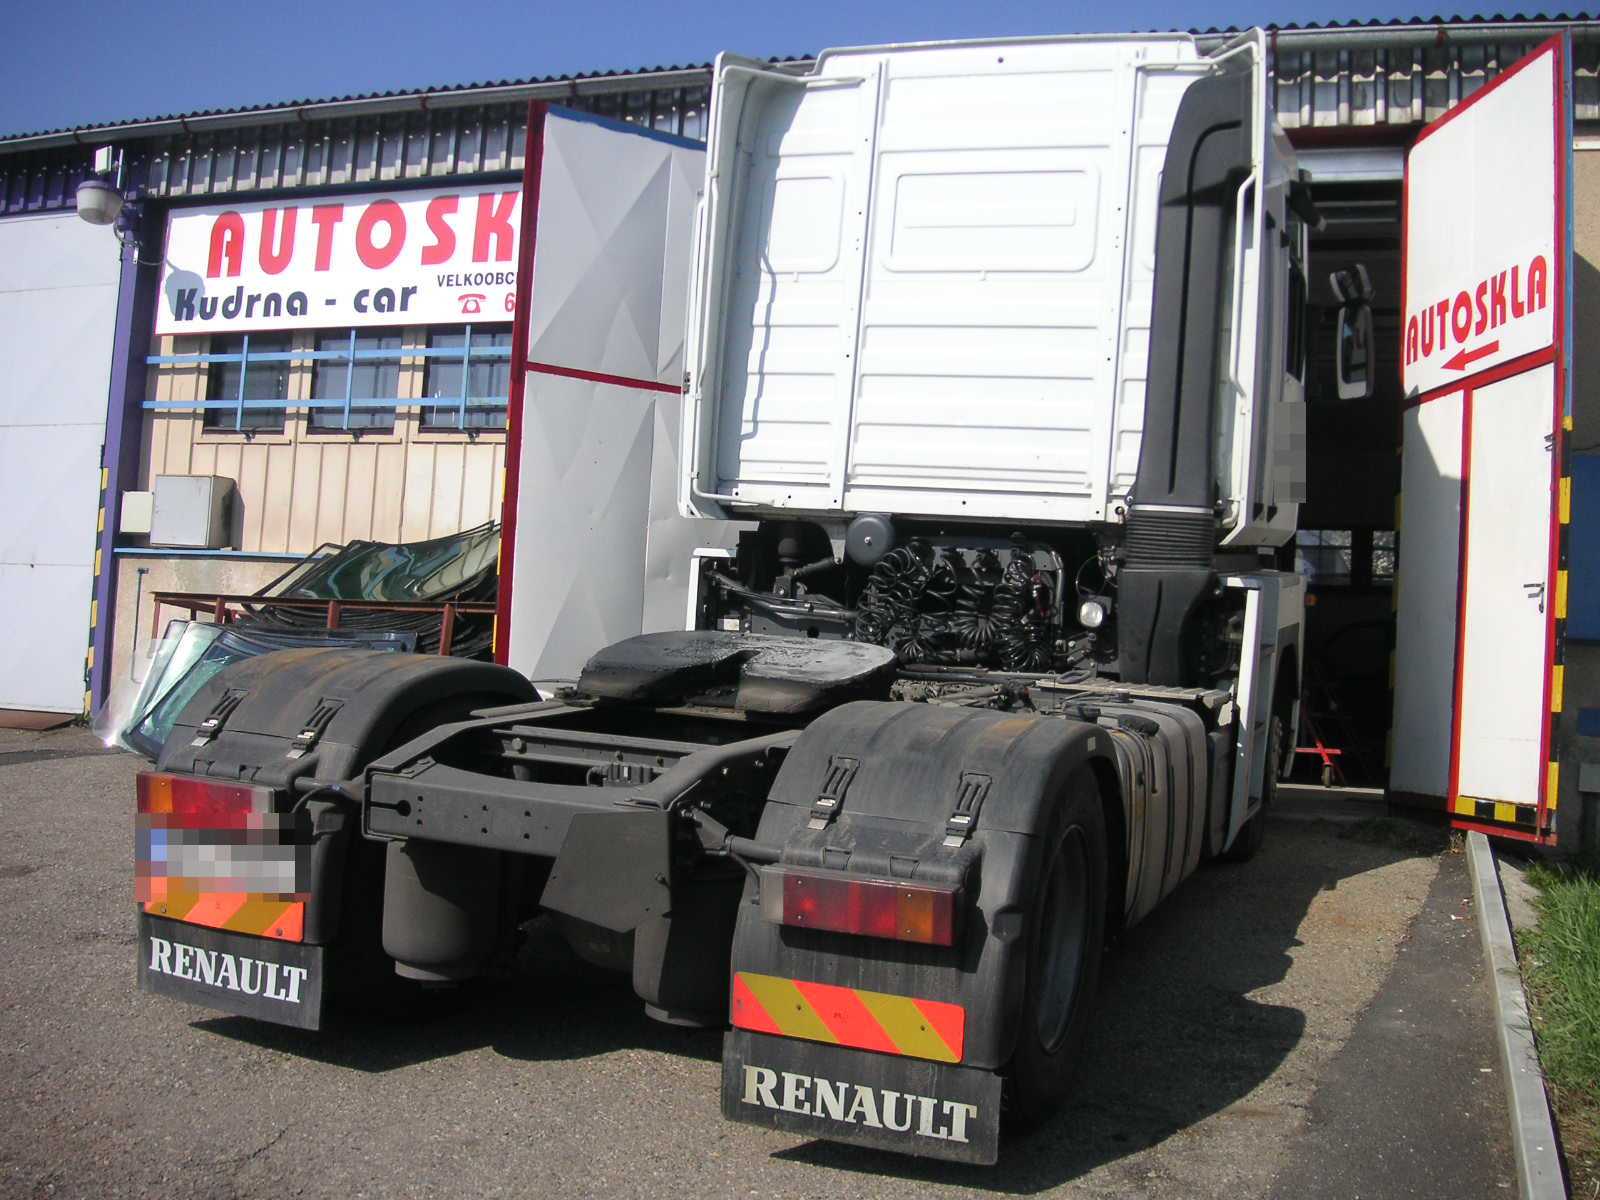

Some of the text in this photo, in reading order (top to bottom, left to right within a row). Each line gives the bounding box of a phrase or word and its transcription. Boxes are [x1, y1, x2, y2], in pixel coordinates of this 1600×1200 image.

[206, 190, 519, 279] AUTOSK
[174, 285, 308, 322] Kudrna
[353, 285, 418, 314] car
[437, 271, 518, 288] VELKOOBC
[1406, 255, 1547, 367] AUTOSKLA
[149, 936, 308, 1004] RENAULT
[741, 1064, 977, 1143] RENAULT
